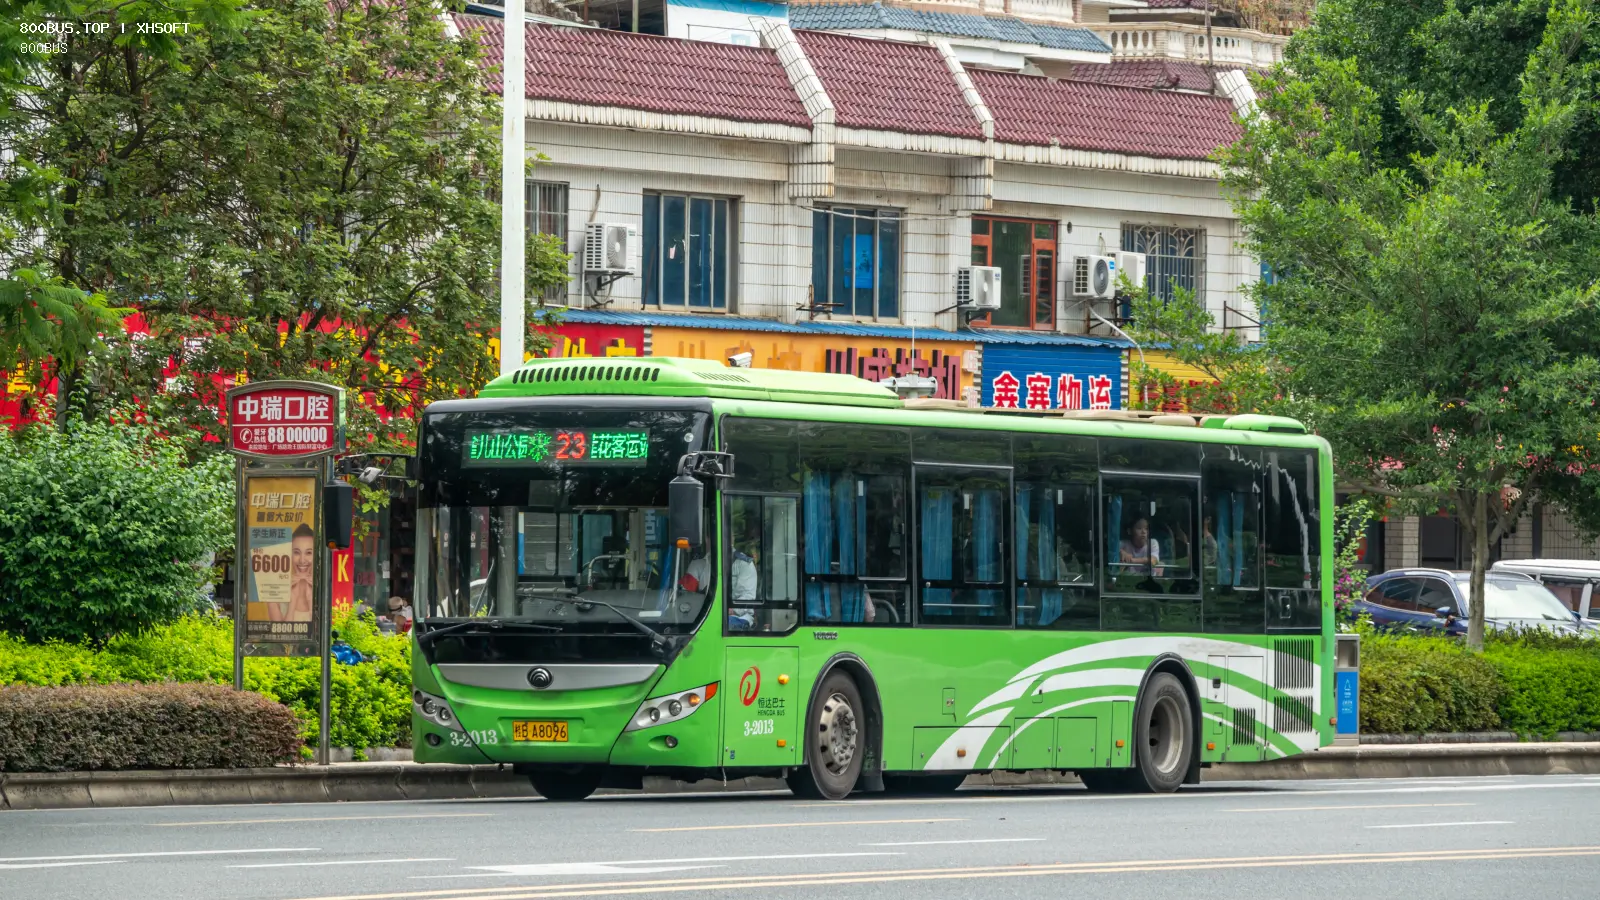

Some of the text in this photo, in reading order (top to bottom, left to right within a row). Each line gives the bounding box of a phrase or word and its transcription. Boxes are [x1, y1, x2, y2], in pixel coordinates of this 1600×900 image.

[238, 395, 329, 421] 中瑞口腔
[556, 432, 586, 459] 23
[251, 492, 311, 509] 中瑞口腔
[252, 554, 291, 573] 6600
[758, 698, 785, 709] 恒达巴士
[743, 719, 774, 737] 3-2013
[450, 729, 498, 748] 3-2013
